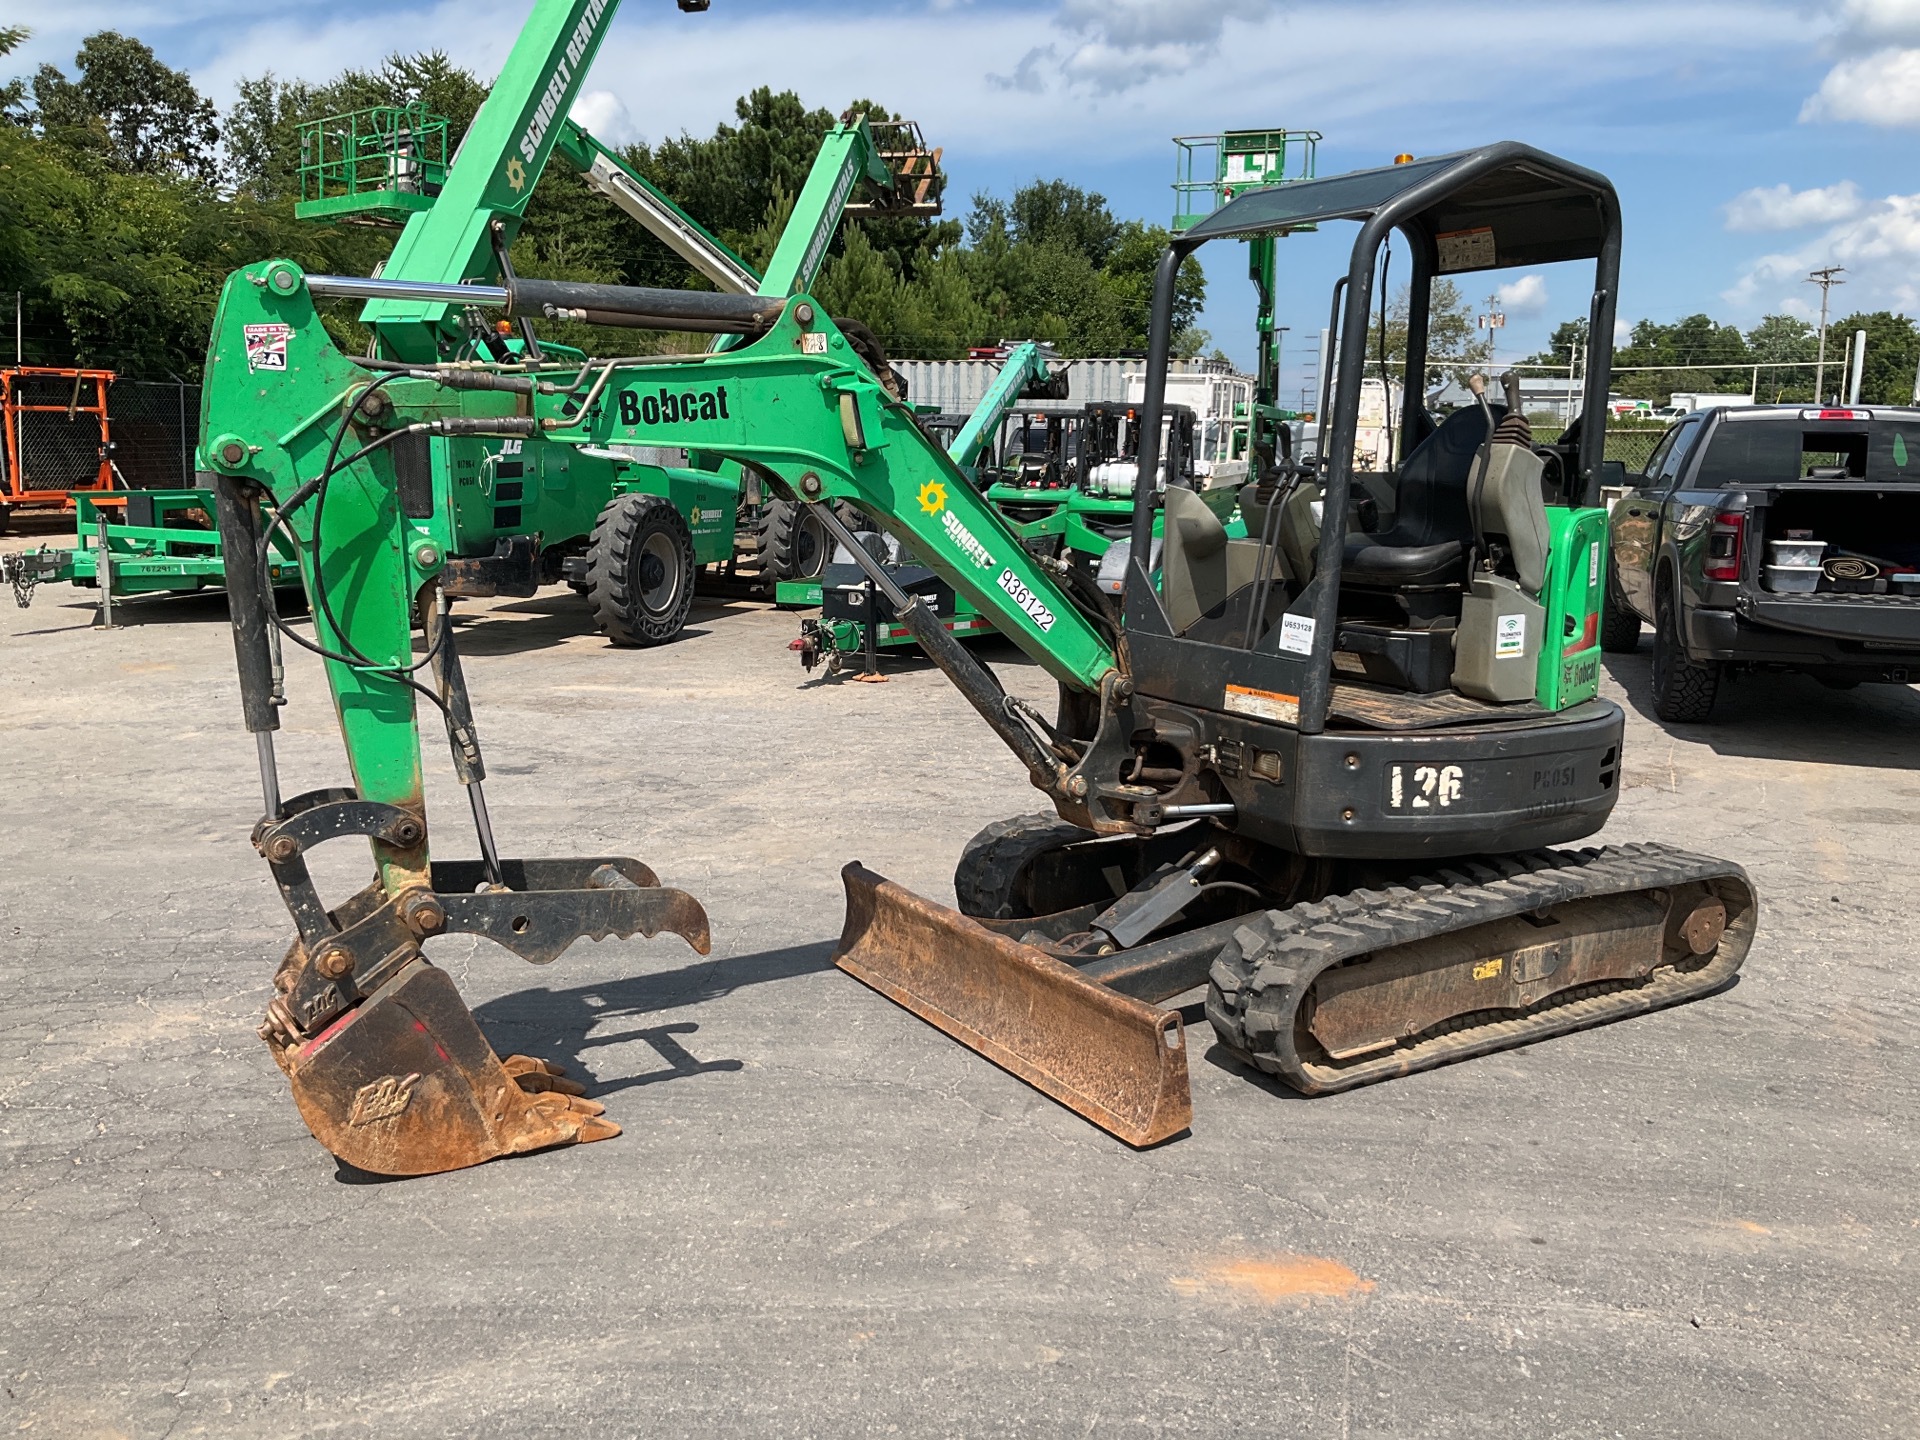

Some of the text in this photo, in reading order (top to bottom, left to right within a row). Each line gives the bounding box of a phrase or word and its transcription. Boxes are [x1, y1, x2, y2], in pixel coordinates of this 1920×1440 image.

[519, 57, 571, 164] SUNBELT
[802, 158, 854, 283] SUNBELT RENTALS
[618, 386, 730, 426] Bobcat
[500, 439, 523, 454] JLG
[941, 510, 997, 570] SUNBELT
[944, 528, 981, 569] RENTALS
[1002, 569, 1055, 631] 936122
[1253, 690, 1275, 699] WARNING
